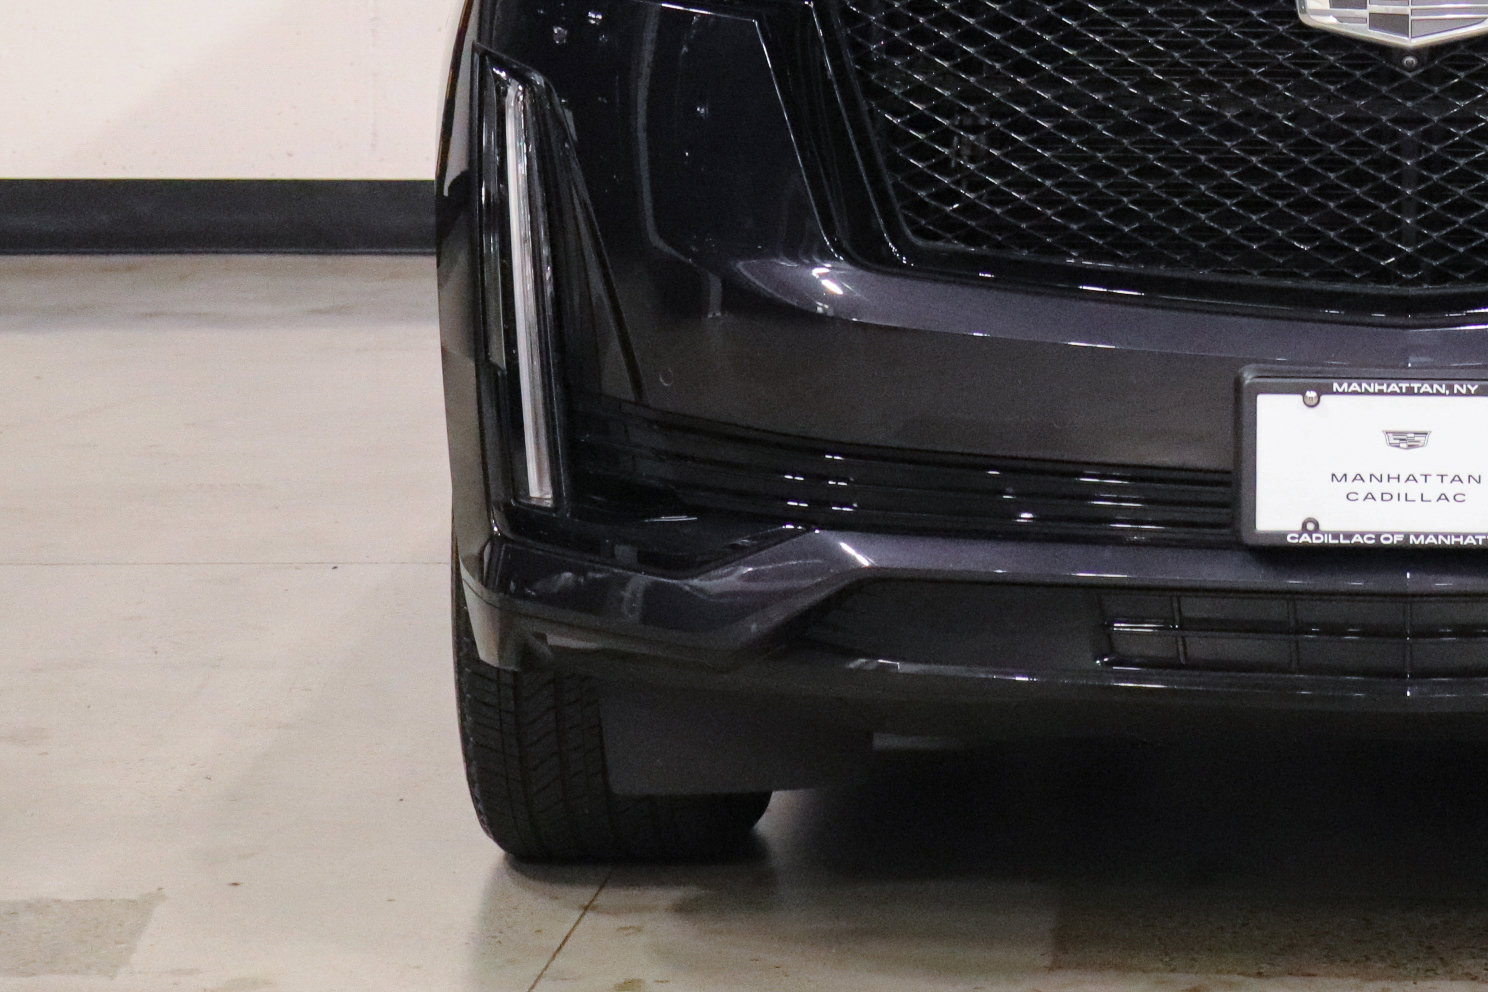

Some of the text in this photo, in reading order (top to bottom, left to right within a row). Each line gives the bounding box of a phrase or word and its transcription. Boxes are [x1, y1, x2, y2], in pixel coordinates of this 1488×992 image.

[1332, 382, 1480, 396] MANHATTAN, NY
[1330, 472, 1483, 485] MANHATTAN
[1345, 491, 1468, 503] CADILLAC
[1286, 533, 1376, 545] CADILLAC
[1380, 534, 1404, 545] OF
